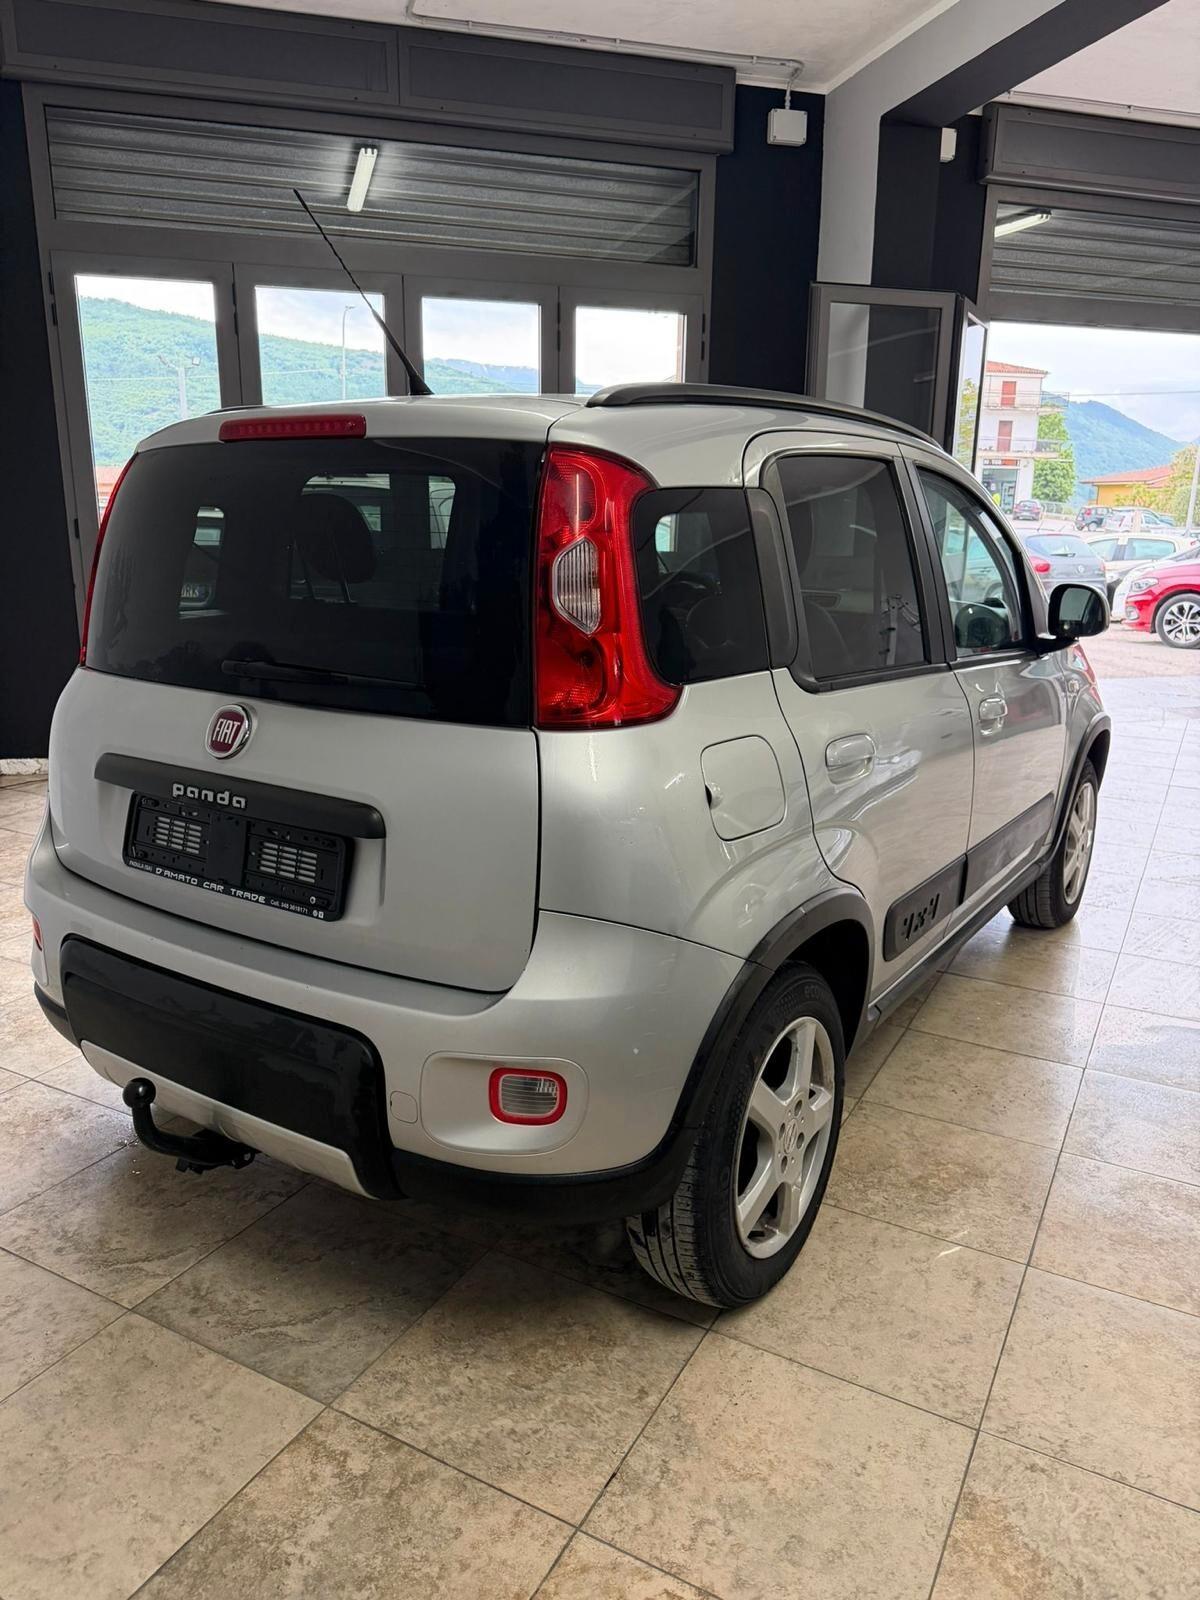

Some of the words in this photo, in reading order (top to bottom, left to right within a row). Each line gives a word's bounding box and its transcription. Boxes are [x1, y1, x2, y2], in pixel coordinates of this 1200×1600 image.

[213, 718, 240, 744] FIAT
[172, 783, 246, 809] panda
[156, 867, 198, 885] D'AMATO
[203, 881, 224, 892] CAR
[230, 888, 265, 904] TRADE
